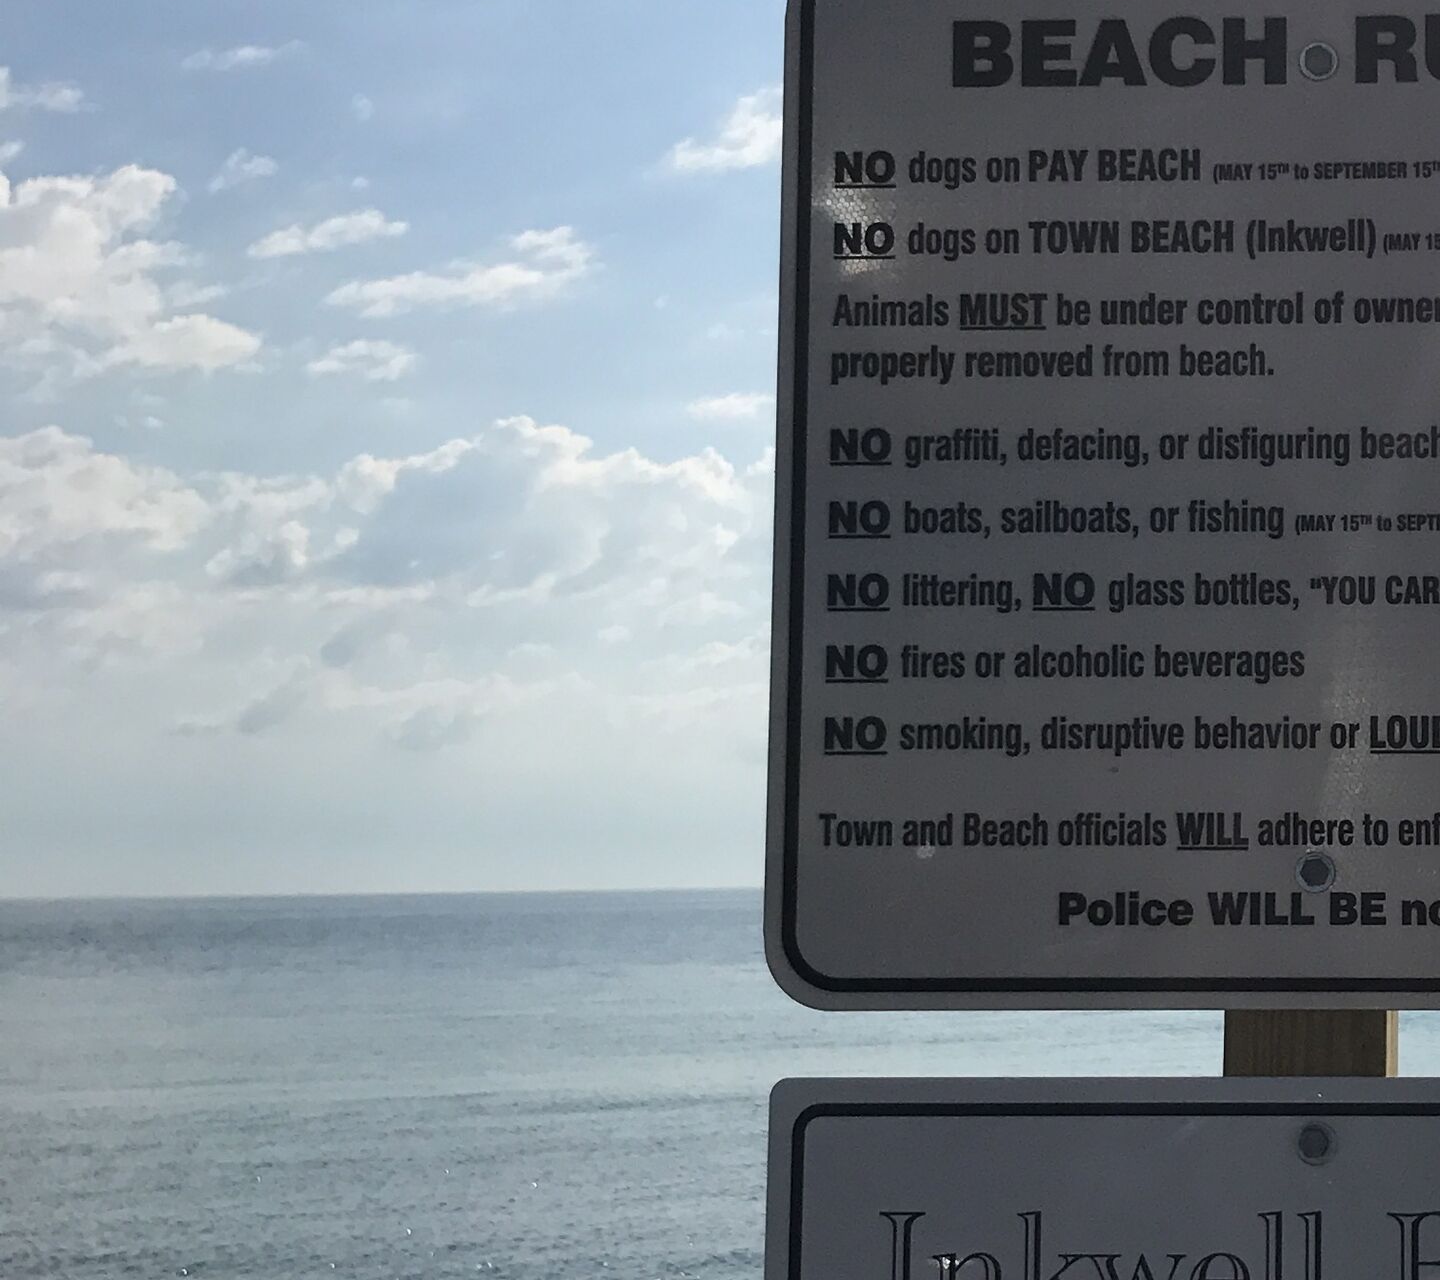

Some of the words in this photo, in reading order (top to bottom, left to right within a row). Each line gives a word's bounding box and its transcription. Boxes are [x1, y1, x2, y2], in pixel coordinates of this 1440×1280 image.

[951, 17, 1288, 87] BEACH
[833, 150, 896, 189] NO
[908, 151, 977, 191] dogs
[986, 157, 1021, 183] on
[1028, 149, 1089, 182] PAY
[1097, 148, 1201, 182] BEACH
[834, 222, 895, 260] NO
[907, 222, 976, 262] dogs
[984, 228, 1020, 255] on
[1027, 220, 1120, 254] TOWN
[1130, 219, 1234, 253] BEACH
[1246, 219, 1377, 259] (Inkwell)
[832, 294, 950, 327] Animals
[959, 293, 1048, 331] MUST
[1056, 293, 1091, 326] be
[1100, 293, 1188, 325] under
[1197, 292, 1304, 325] control
[1314, 291, 1345, 324] of
[830, 345, 956, 385] properly
[964, 345, 1093, 377] removed
[1102, 344, 1170, 377] from
[1179, 344, 1275, 376] beach.
[829, 428, 892, 466] NO
[904, 428, 1007, 468] graffiti,
[1017, 427, 1149, 467] defacing,
[1158, 434, 1190, 461] or
[1197, 426, 1350, 467] disfiguring
[828, 500, 891, 539] NO
[903, 501, 991, 538] boats,
[1000, 500, 1139, 536] sailboats,
[1149, 507, 1180, 533] or
[1187, 499, 1285, 540] fishing
[827, 573, 890, 612] NO
[902, 574, 1022, 613] littering,
[1032, 573, 1096, 611] NO
[1108, 573, 1185, 613] glass
[1194, 572, 1300, 609] bottles,
[825, 644, 889, 683] NO
[900, 645, 966, 678] fires
[974, 652, 1006, 678] or
[1014, 644, 1145, 677] alcoholic
[1154, 645, 1305, 684] beverages
[823, 716, 887, 755] NO
[899, 716, 1031, 757] smoking,
[1040, 716, 1184, 756] disruptive
[1194, 715, 1321, 750] behavior
[1329, 723, 1361, 749] or
[818, 813, 893, 847] Town
[902, 813, 953, 847] and
[962, 813, 1049, 846] Beach
[1057, 812, 1167, 846] officials
[1176, 812, 1250, 851] WILL
[1257, 812, 1355, 848] adhere
[1362, 814, 1389, 846] to
[1058, 892, 1194, 926] Police
[1207, 892, 1315, 925] WILL
[1329, 892, 1387, 925] BE
